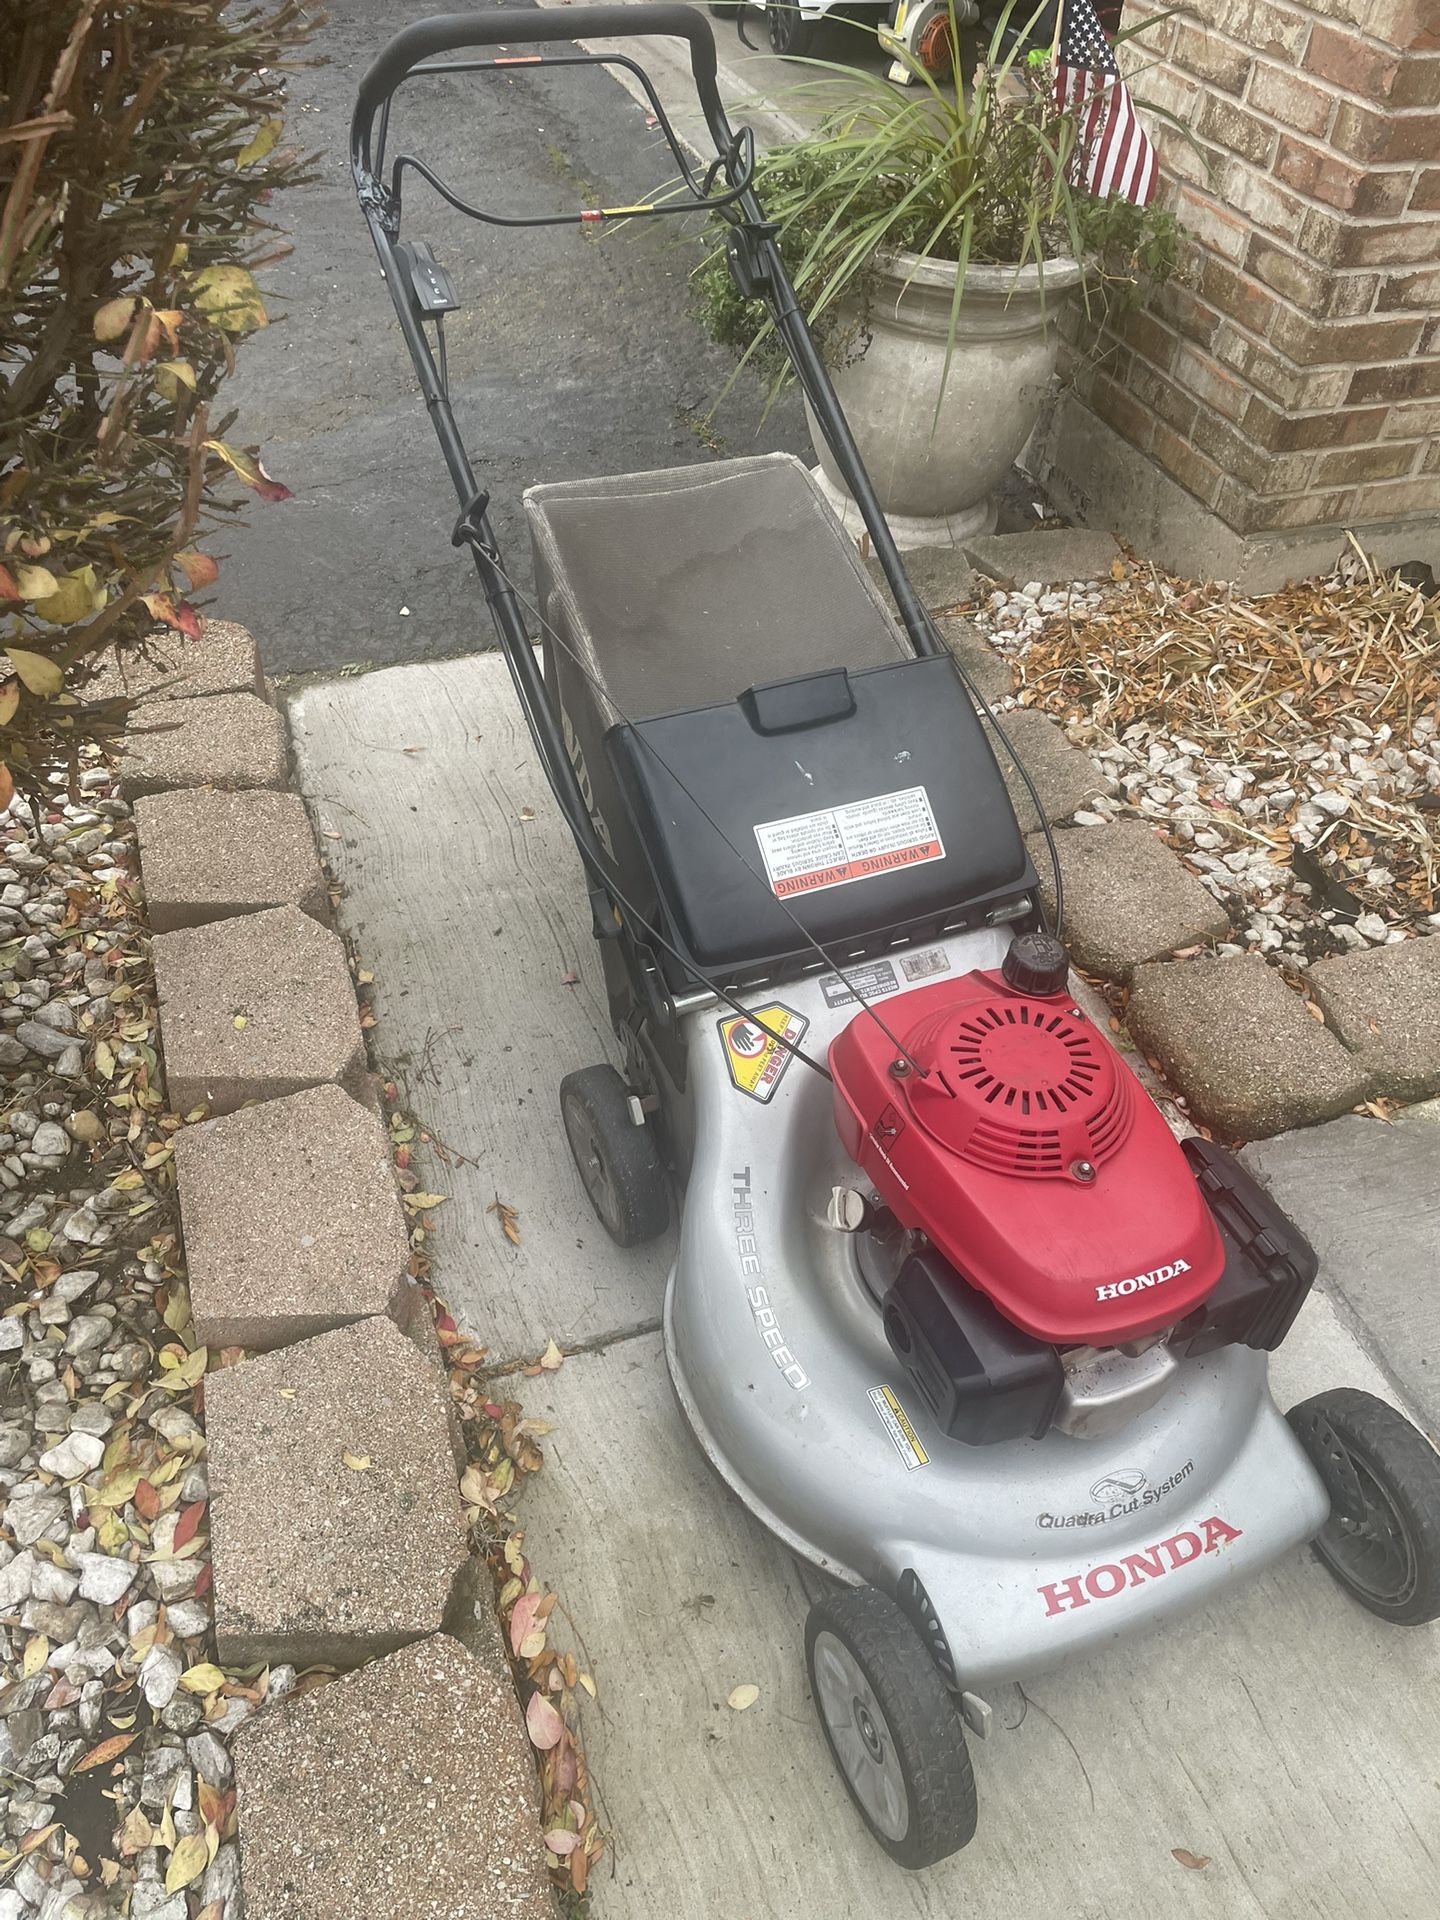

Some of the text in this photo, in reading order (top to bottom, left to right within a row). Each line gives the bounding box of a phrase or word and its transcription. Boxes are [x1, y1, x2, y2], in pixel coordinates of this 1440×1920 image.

[861, 849, 918, 871] WARNING
[777, 870, 835, 893] WARNING
[833, 997, 851, 1005] SAFETY
[760, 1028, 796, 1084] DNGER
[748, 1072, 759, 1087] AWAY
[733, 1166, 811, 1391] THREE SPEED
[1096, 1259, 1192, 1301] HONDA
[897, 1414, 915, 1441] CAUTION
[1038, 1460, 1194, 1528] Quadra Cut System
[1037, 1516, 1243, 1617] HONDA
